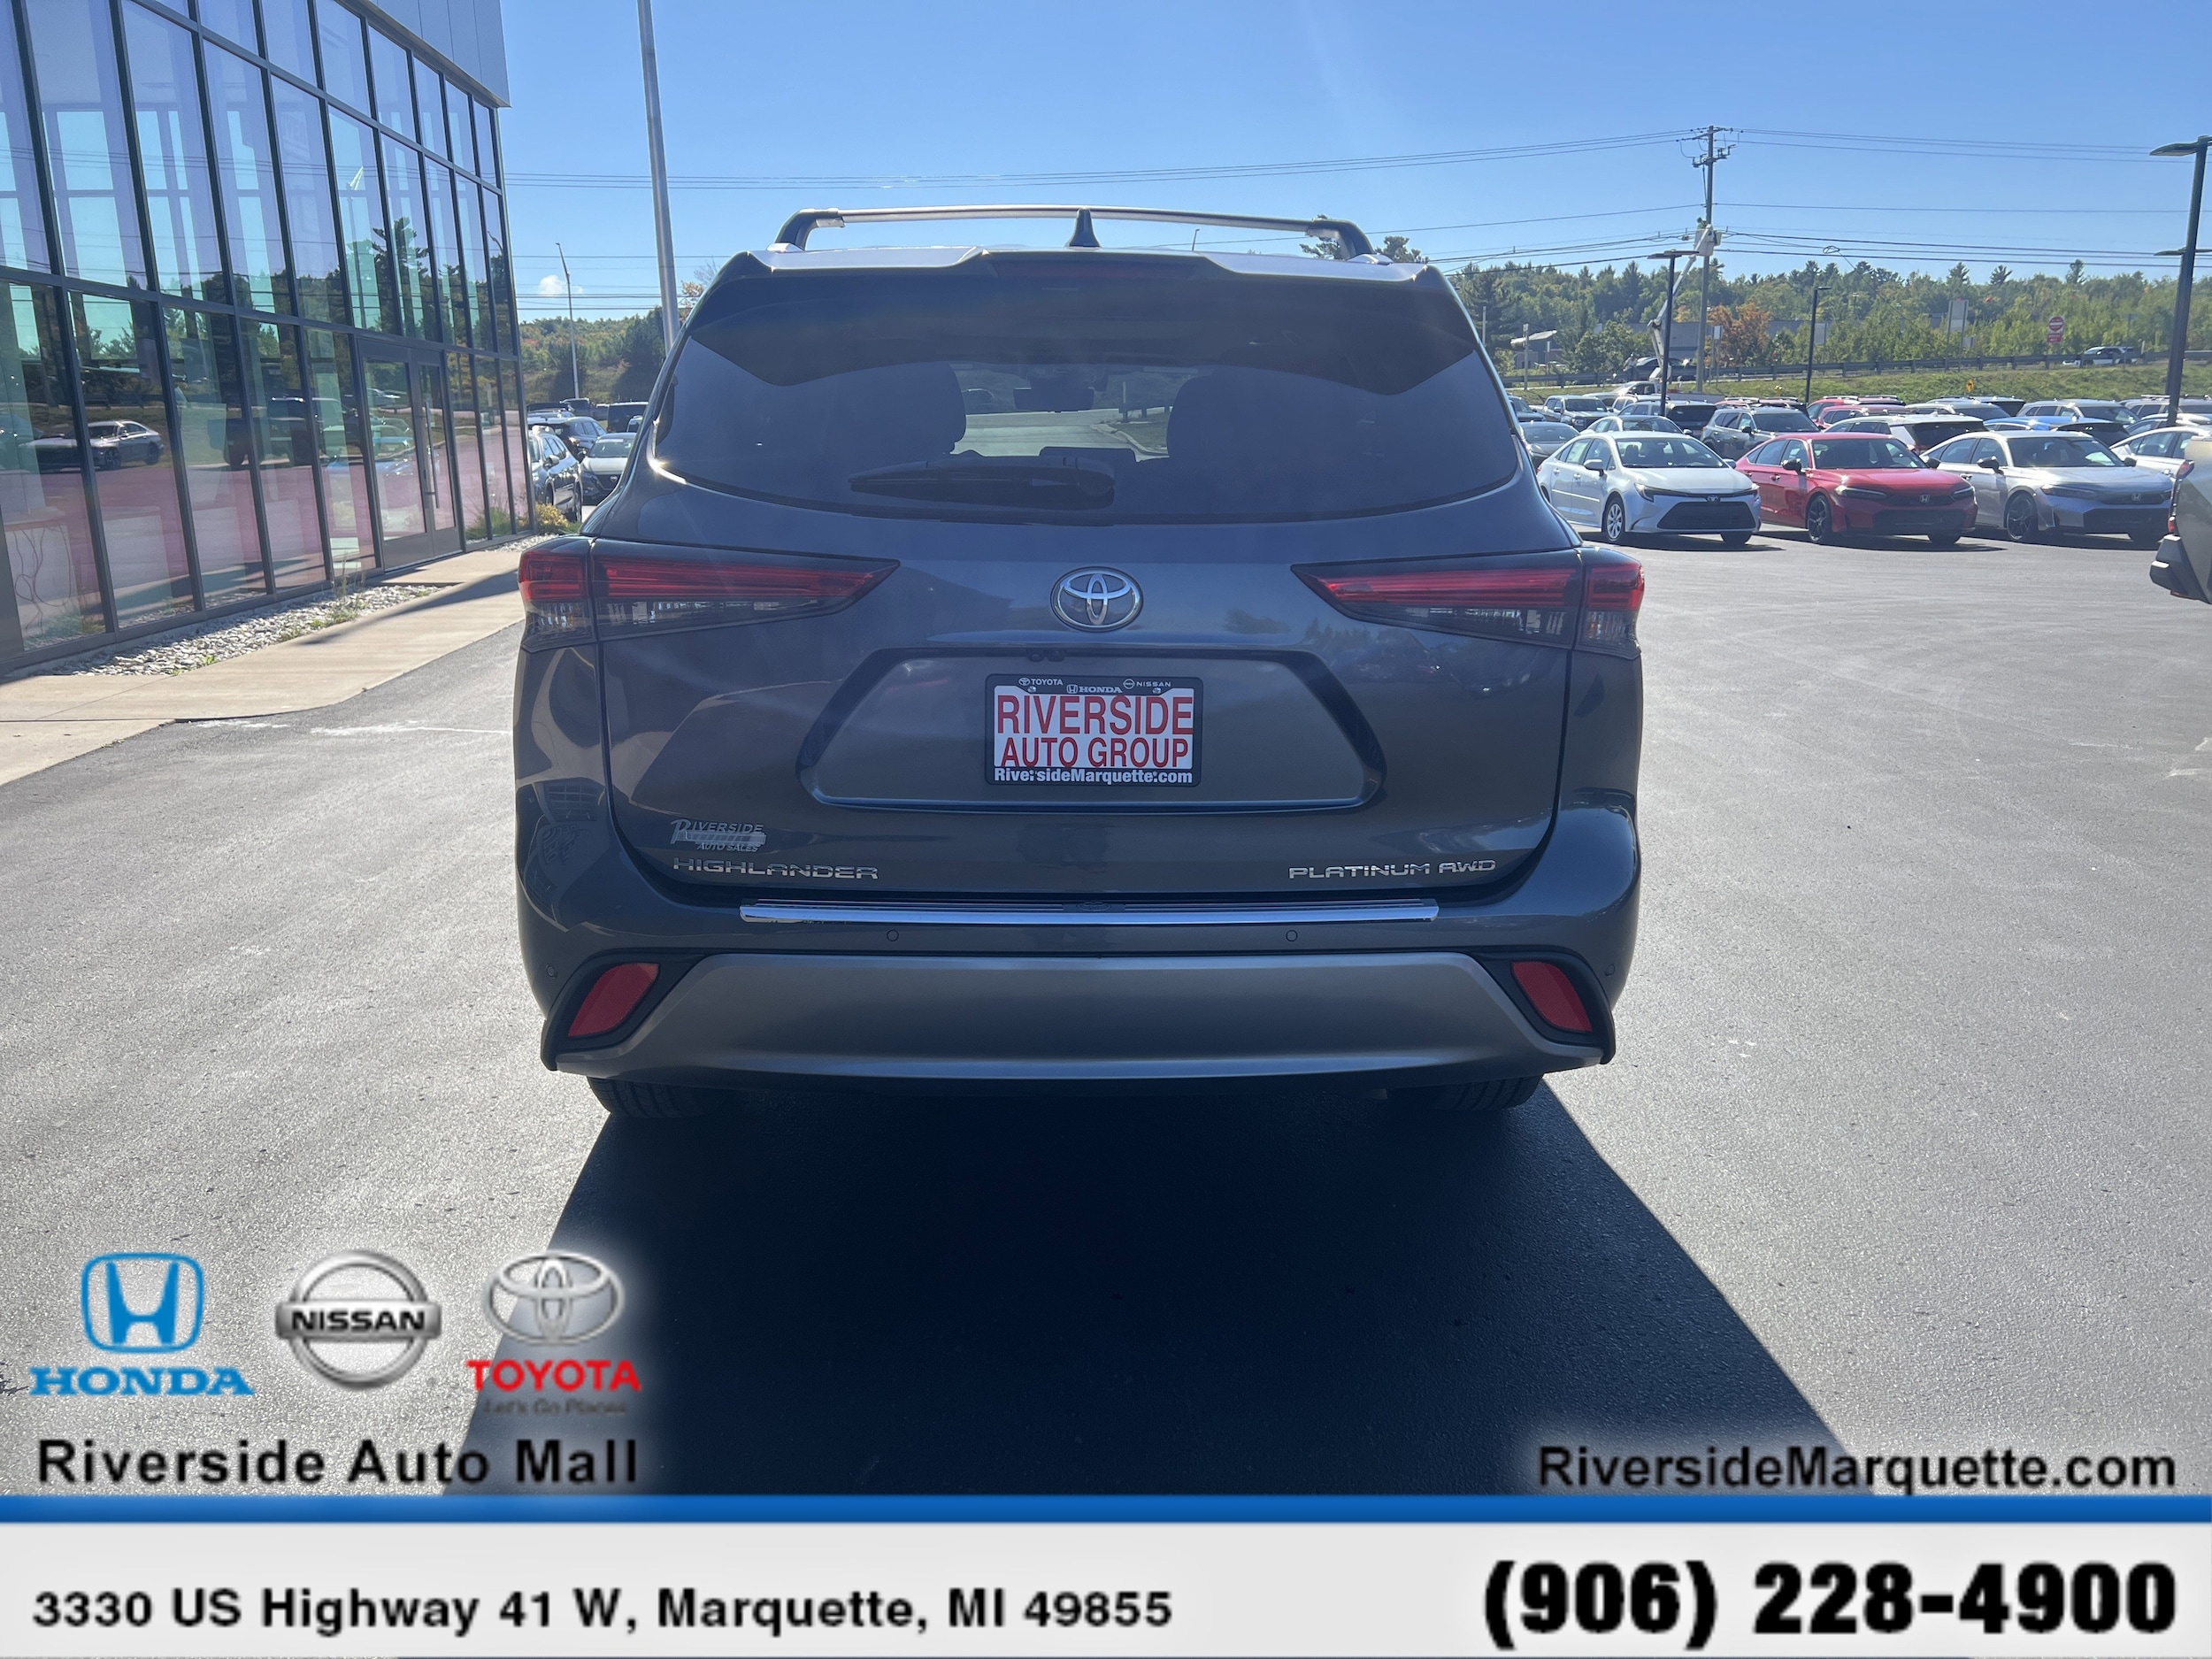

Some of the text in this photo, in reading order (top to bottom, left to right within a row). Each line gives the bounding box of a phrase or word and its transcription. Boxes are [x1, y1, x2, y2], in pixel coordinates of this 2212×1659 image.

[997, 695, 1194, 735] RIVERSIDE
[1001, 737, 1189, 768] AUTO GROUP
[696, 841, 759, 853] AUTO SALES
[672, 857, 879, 879] HIGHLANDER
[1288, 859, 1496, 879] PLATINUM AWD
